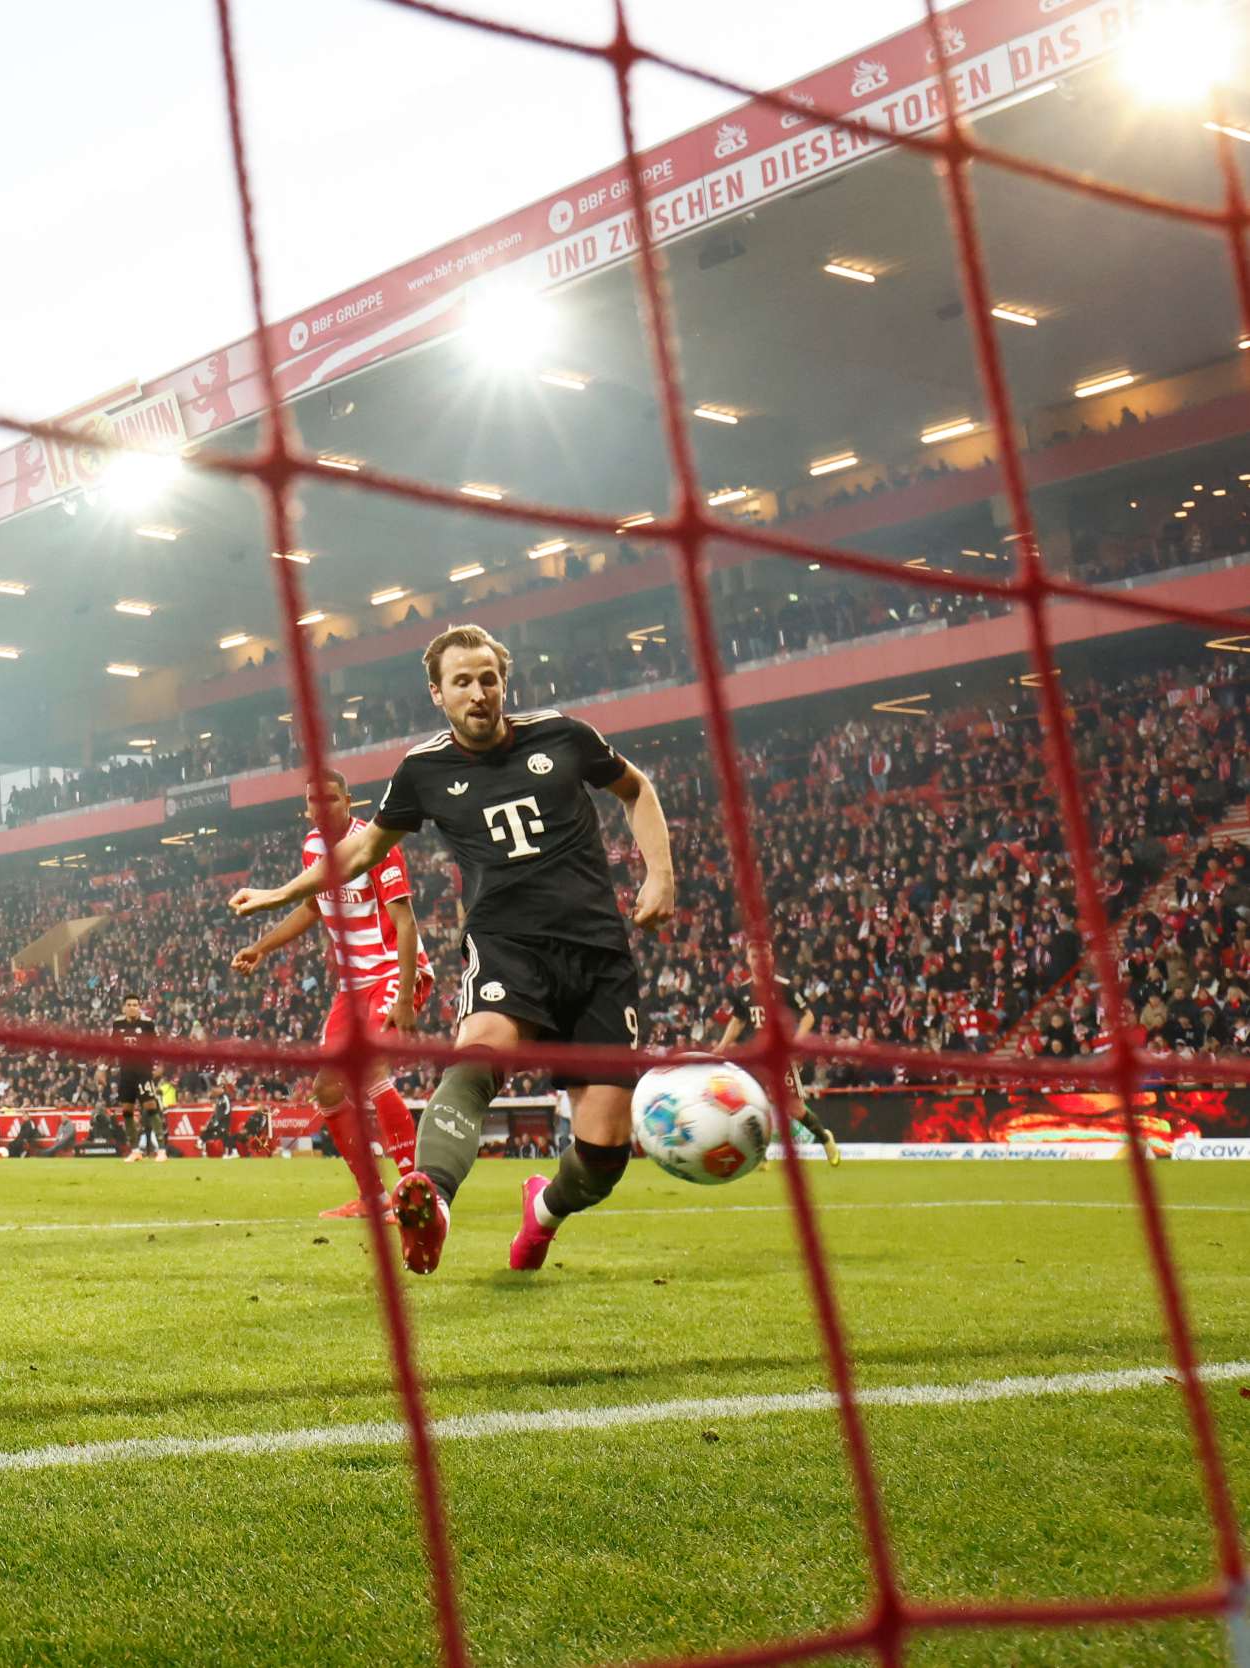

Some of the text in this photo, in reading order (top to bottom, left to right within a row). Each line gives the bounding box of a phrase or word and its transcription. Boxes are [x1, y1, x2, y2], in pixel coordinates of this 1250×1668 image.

[546, 235, 598, 279] UND
[607, 170, 745, 254] ZWSCHEN
[760, 116, 871, 188] DIESEN
[1009, 24, 1082, 81] DAS
[578, 158, 673, 214] BBF GRPPE
[406, 231, 522, 292] www.bbf-gruppe.com
[311, 290, 383, 334] BBF GRUPPE
[482, 795, 545, 859] T
[383, 979, 400, 1004] 5
[623, 1006, 639, 1050] 9
[138, 1080, 154, 1097] 14
[1200, 1145, 1245, 1158] eaw
